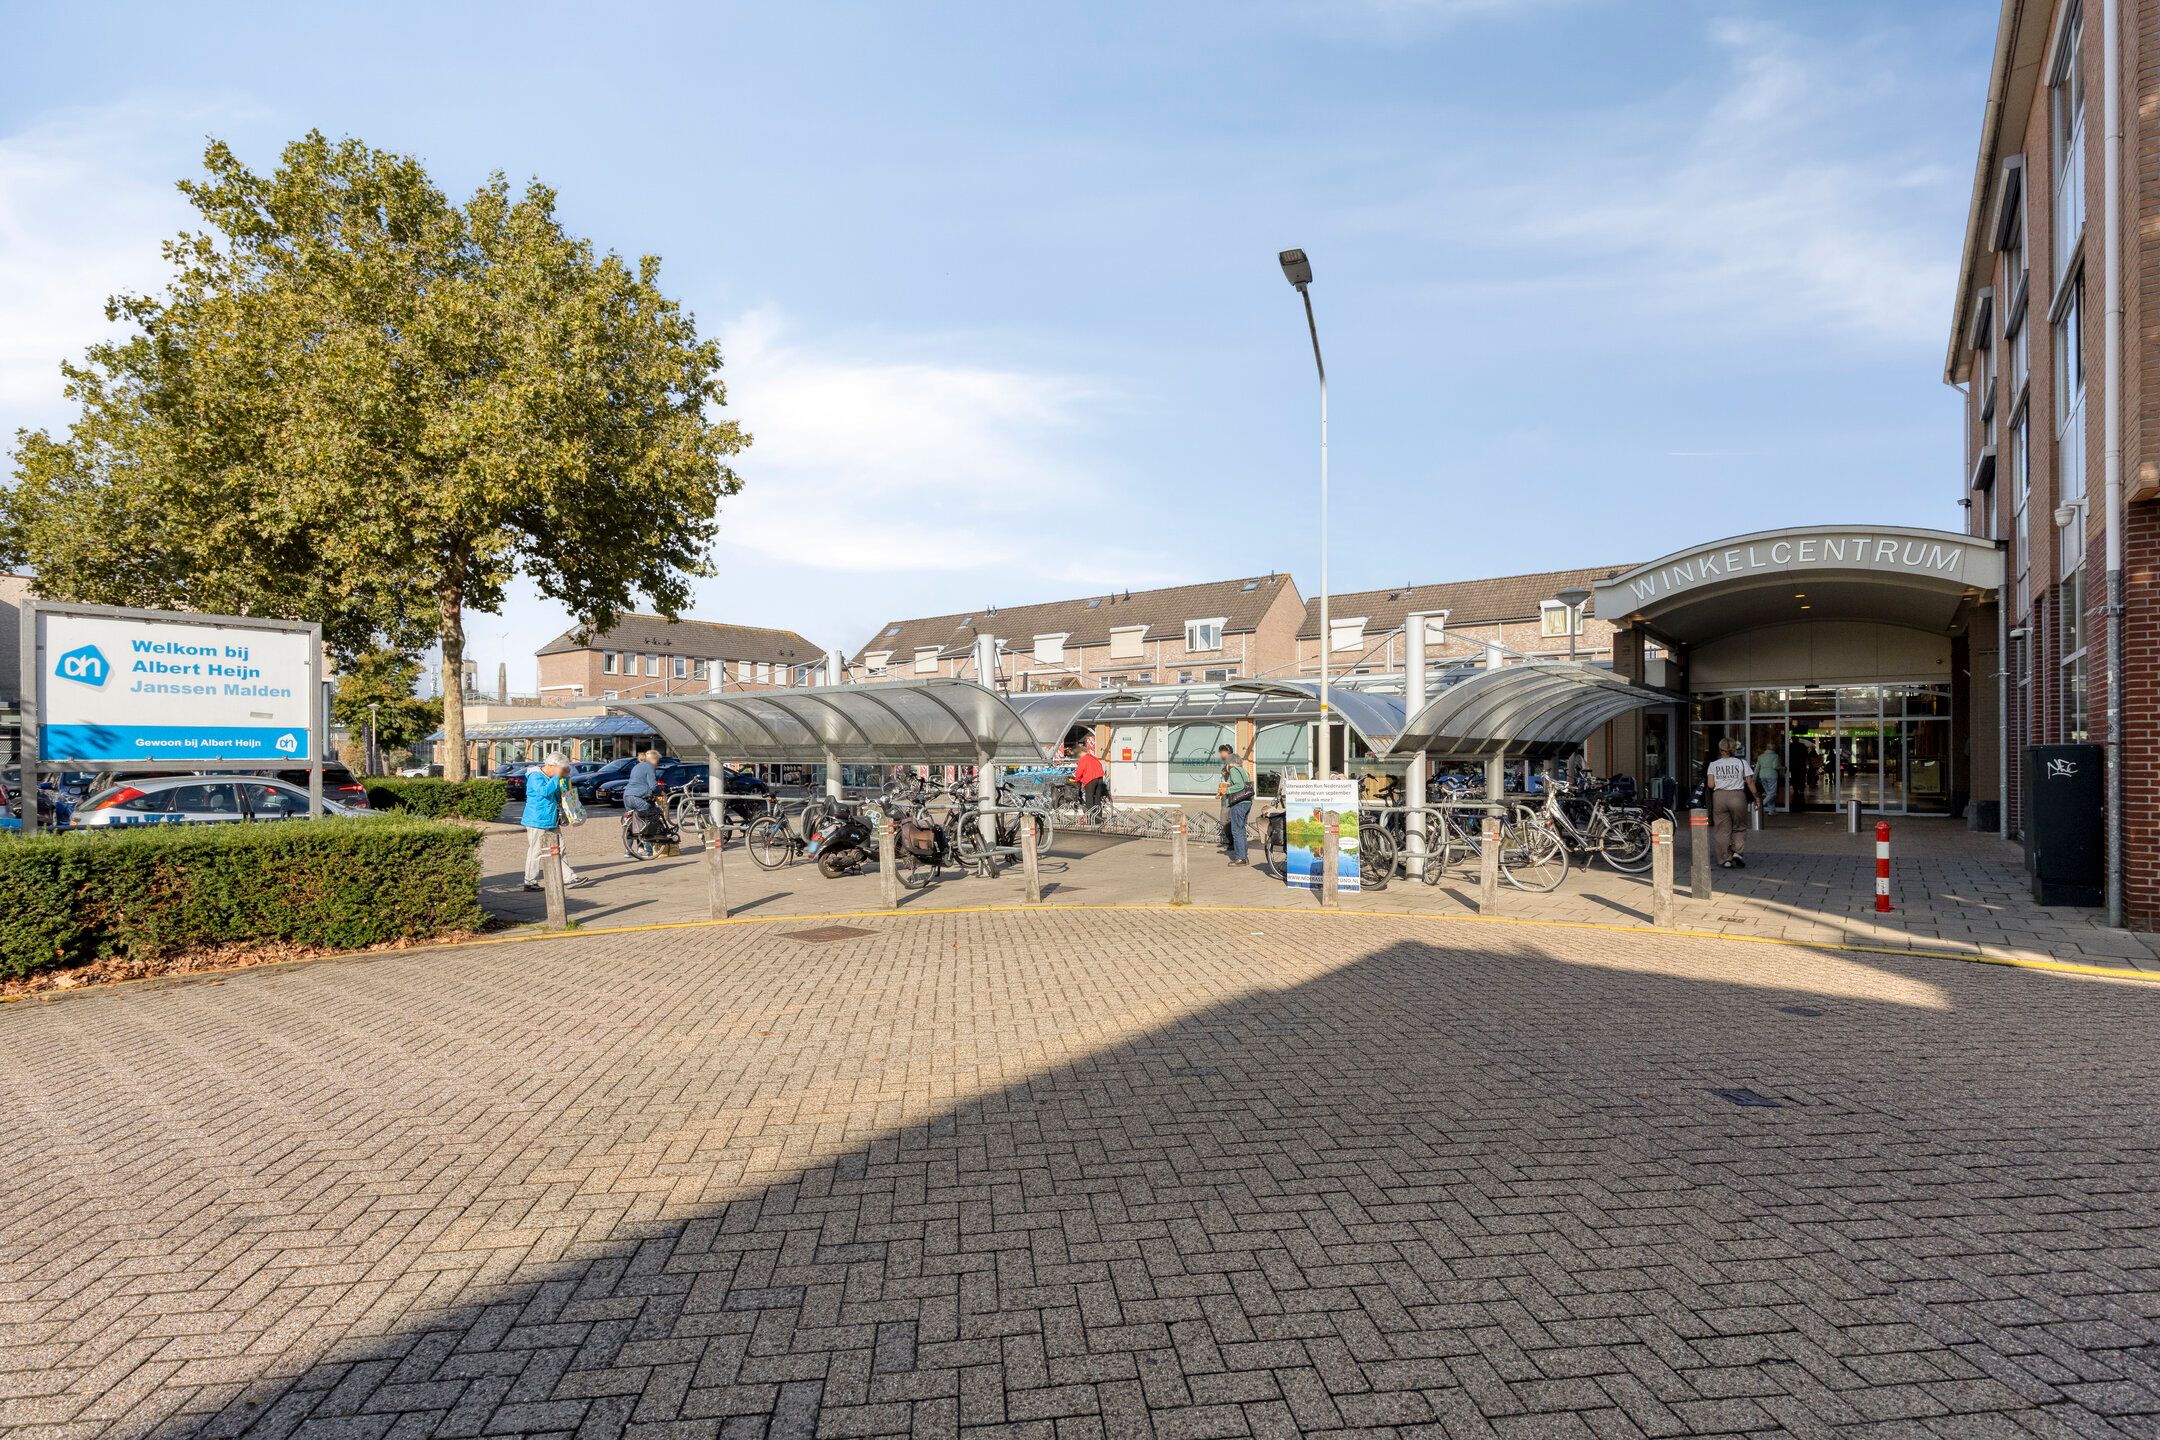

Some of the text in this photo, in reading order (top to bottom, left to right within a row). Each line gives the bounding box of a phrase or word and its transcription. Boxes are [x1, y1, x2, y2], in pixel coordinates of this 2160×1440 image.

[1628, 537, 1962, 600] WINKELCENTRUM
[131, 639, 249, 662] Welkom bij
[132, 660, 260, 680] Albert Heijn
[130, 680, 291, 698] Janssen Malden
[135, 738, 262, 749] Gewoon bij Albert Heijn
[1715, 764, 1740, 776] PARIS
[2047, 758, 2079, 779] NEC
